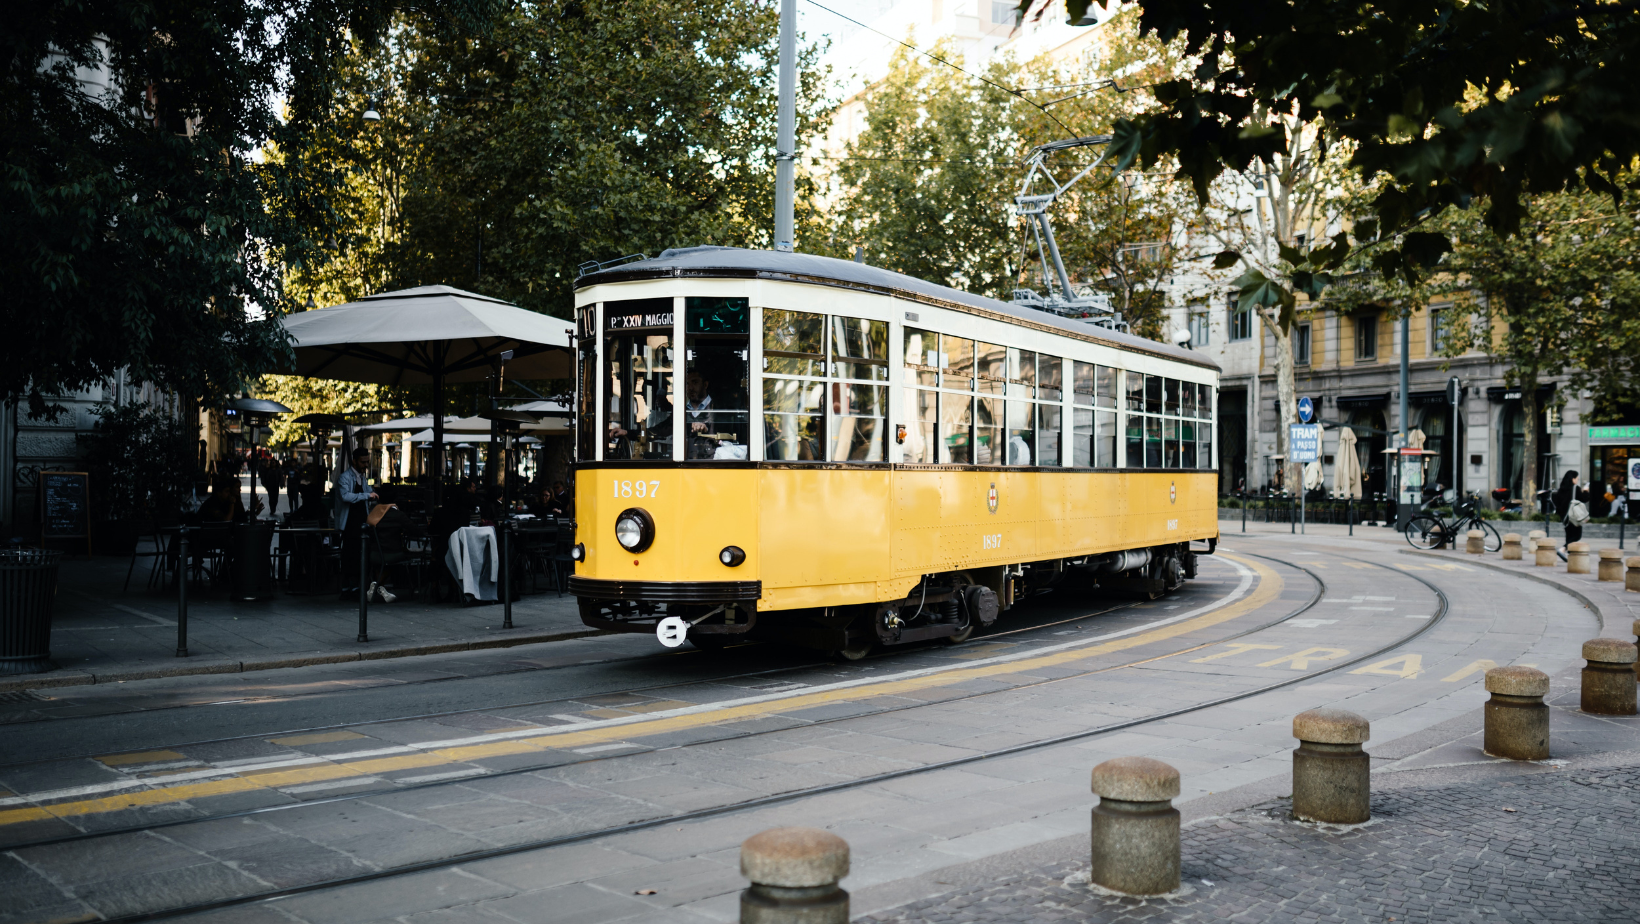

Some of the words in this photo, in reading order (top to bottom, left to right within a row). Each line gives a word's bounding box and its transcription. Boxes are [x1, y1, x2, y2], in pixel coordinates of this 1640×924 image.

[583, 306, 596, 338] 10
[622, 314, 643, 328] XXIV
[645, 312, 674, 326] MAGGIO
[1291, 428, 1317, 439] TRAM
[1297, 441, 1316, 449] PASSO
[1293, 451, 1316, 460] D'UOMO
[613, 480, 661, 498] 1897
[983, 534, 1002, 550] 1897
